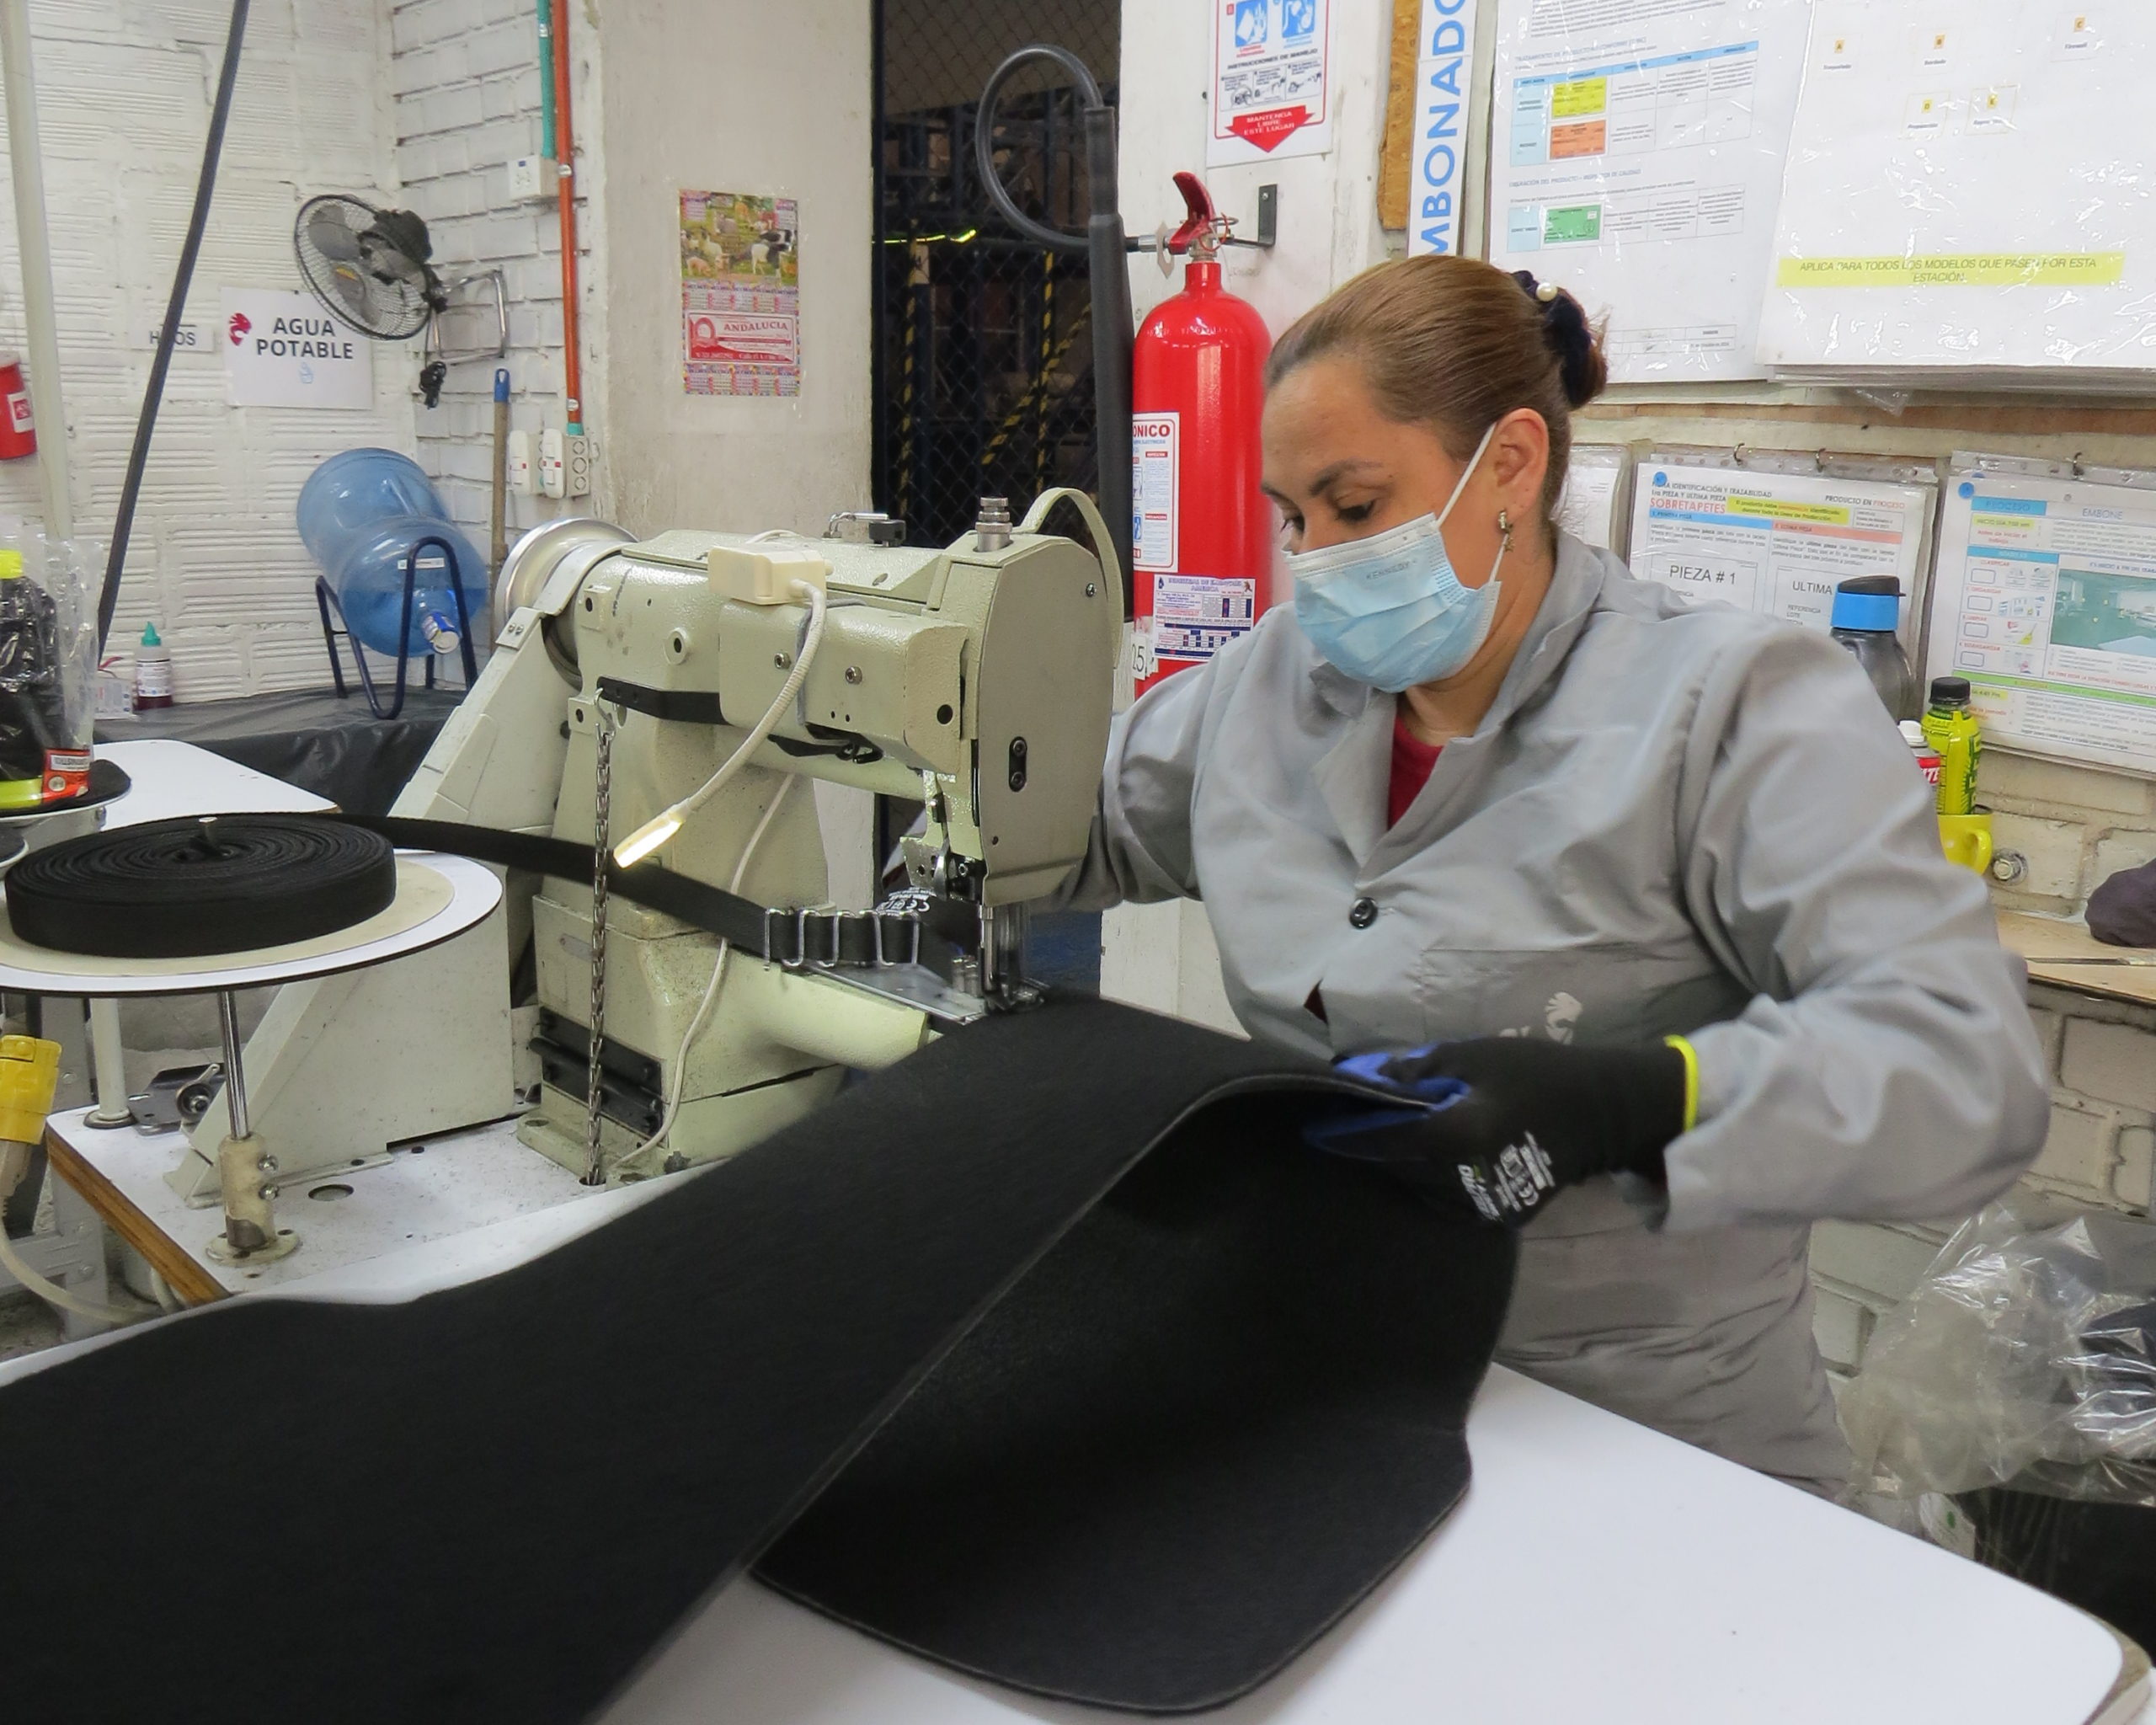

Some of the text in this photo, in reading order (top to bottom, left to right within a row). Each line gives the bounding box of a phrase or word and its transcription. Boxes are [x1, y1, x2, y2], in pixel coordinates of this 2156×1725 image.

[1799, 261, 1835, 272] APLICA
[1837, 260, 1863, 271] PARA
[1865, 260, 1900, 270] TODOS
[1902, 259, 1923, 270] LOS
[1924, 259, 1977, 270] MODELOS
[1978, 258, 2003, 269] QUE
[2068, 258, 2096, 268] ESTA
[273, 318, 336, 337] AGUA
[724, 322, 788, 332] ANDALUCIA
[149, 330, 196, 346] HOS
[256, 339, 354, 360] POTABLE
[1672, 483, 1723, 493] IDENTIFICACIÓN
[1729, 488, 1772, 498] TRAZABILIDAD
[1686, 493, 1706, 501] ULTIMA
[1650, 497, 1726, 514] SOBRETAPETES
[1825, 494, 1862, 505] PRODUCTO
[1862, 498, 1872, 506] EN
[2082, 508, 2123, 520] EMBONE
[1669, 564, 1736, 585] PIEZA # 1
[1792, 579, 1833, 595] ULTIMA
[1787, 605, 1821, 614] REFERENCIA
